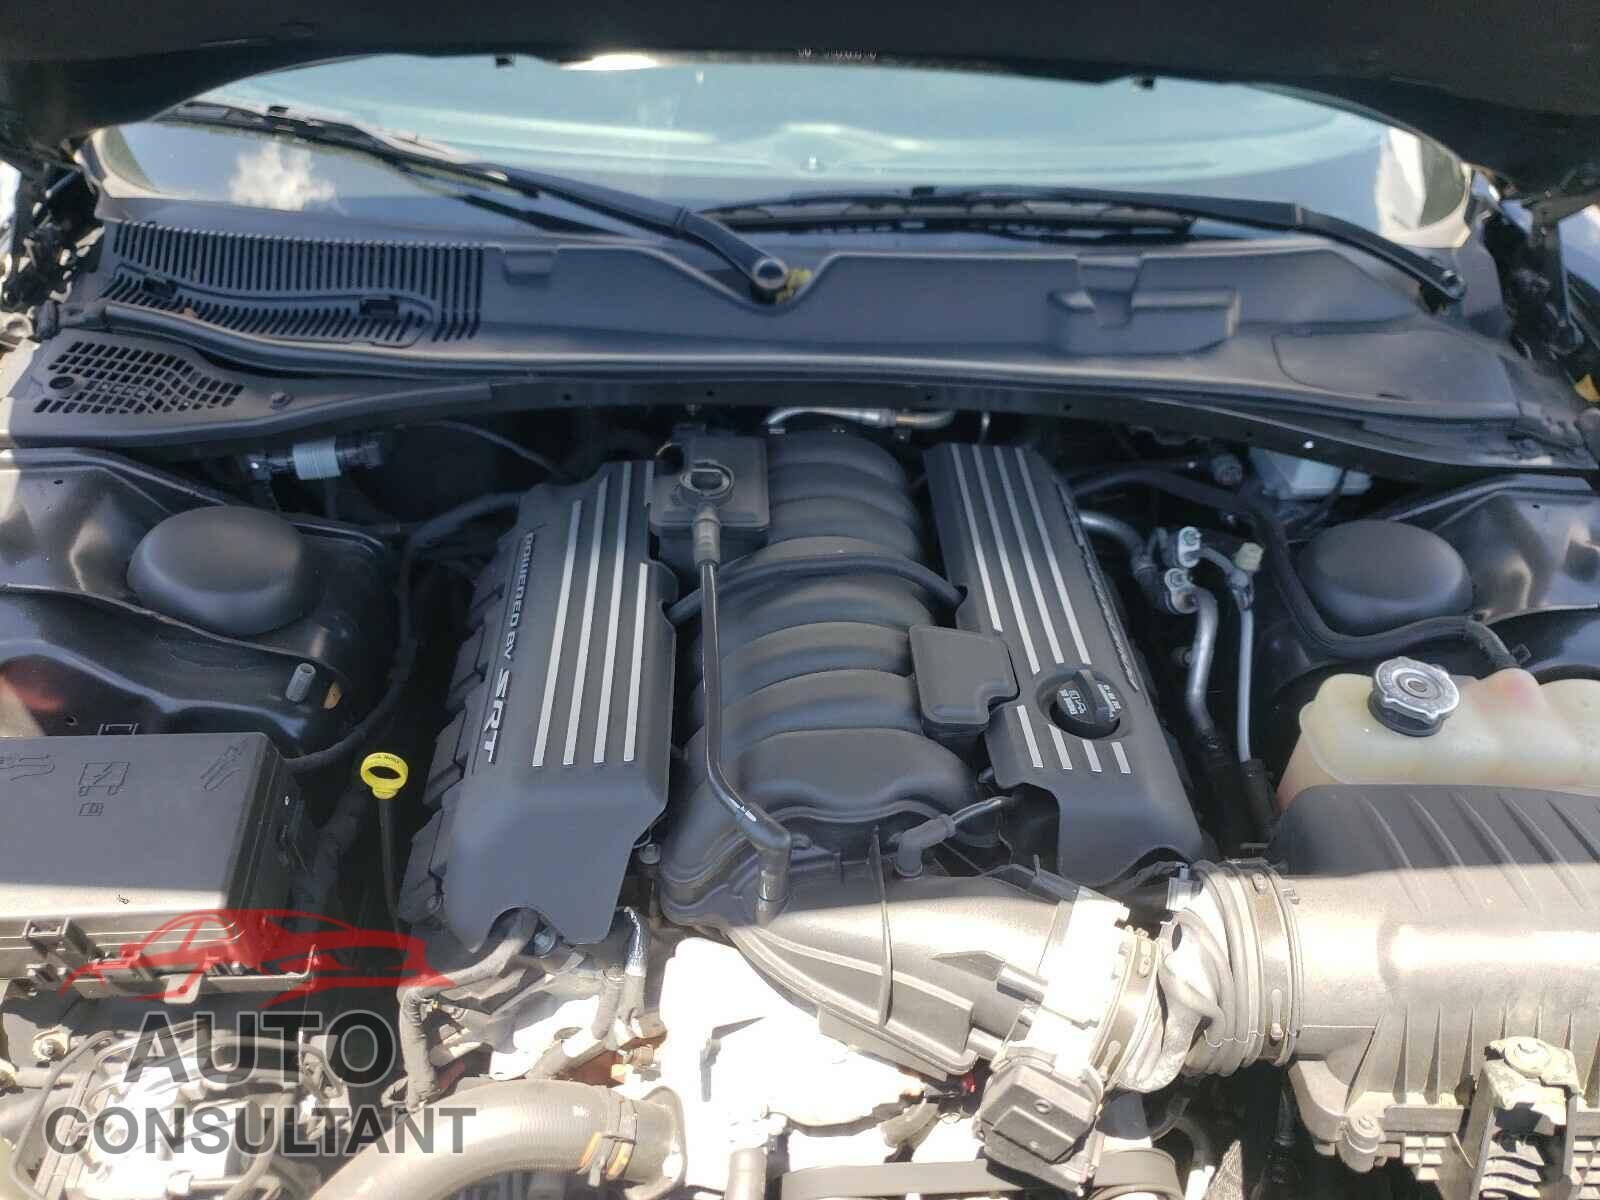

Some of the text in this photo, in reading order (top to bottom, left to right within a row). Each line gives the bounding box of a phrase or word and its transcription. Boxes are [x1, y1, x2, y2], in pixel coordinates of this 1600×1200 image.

[483, 532, 535, 763] POWERED BY SRT
